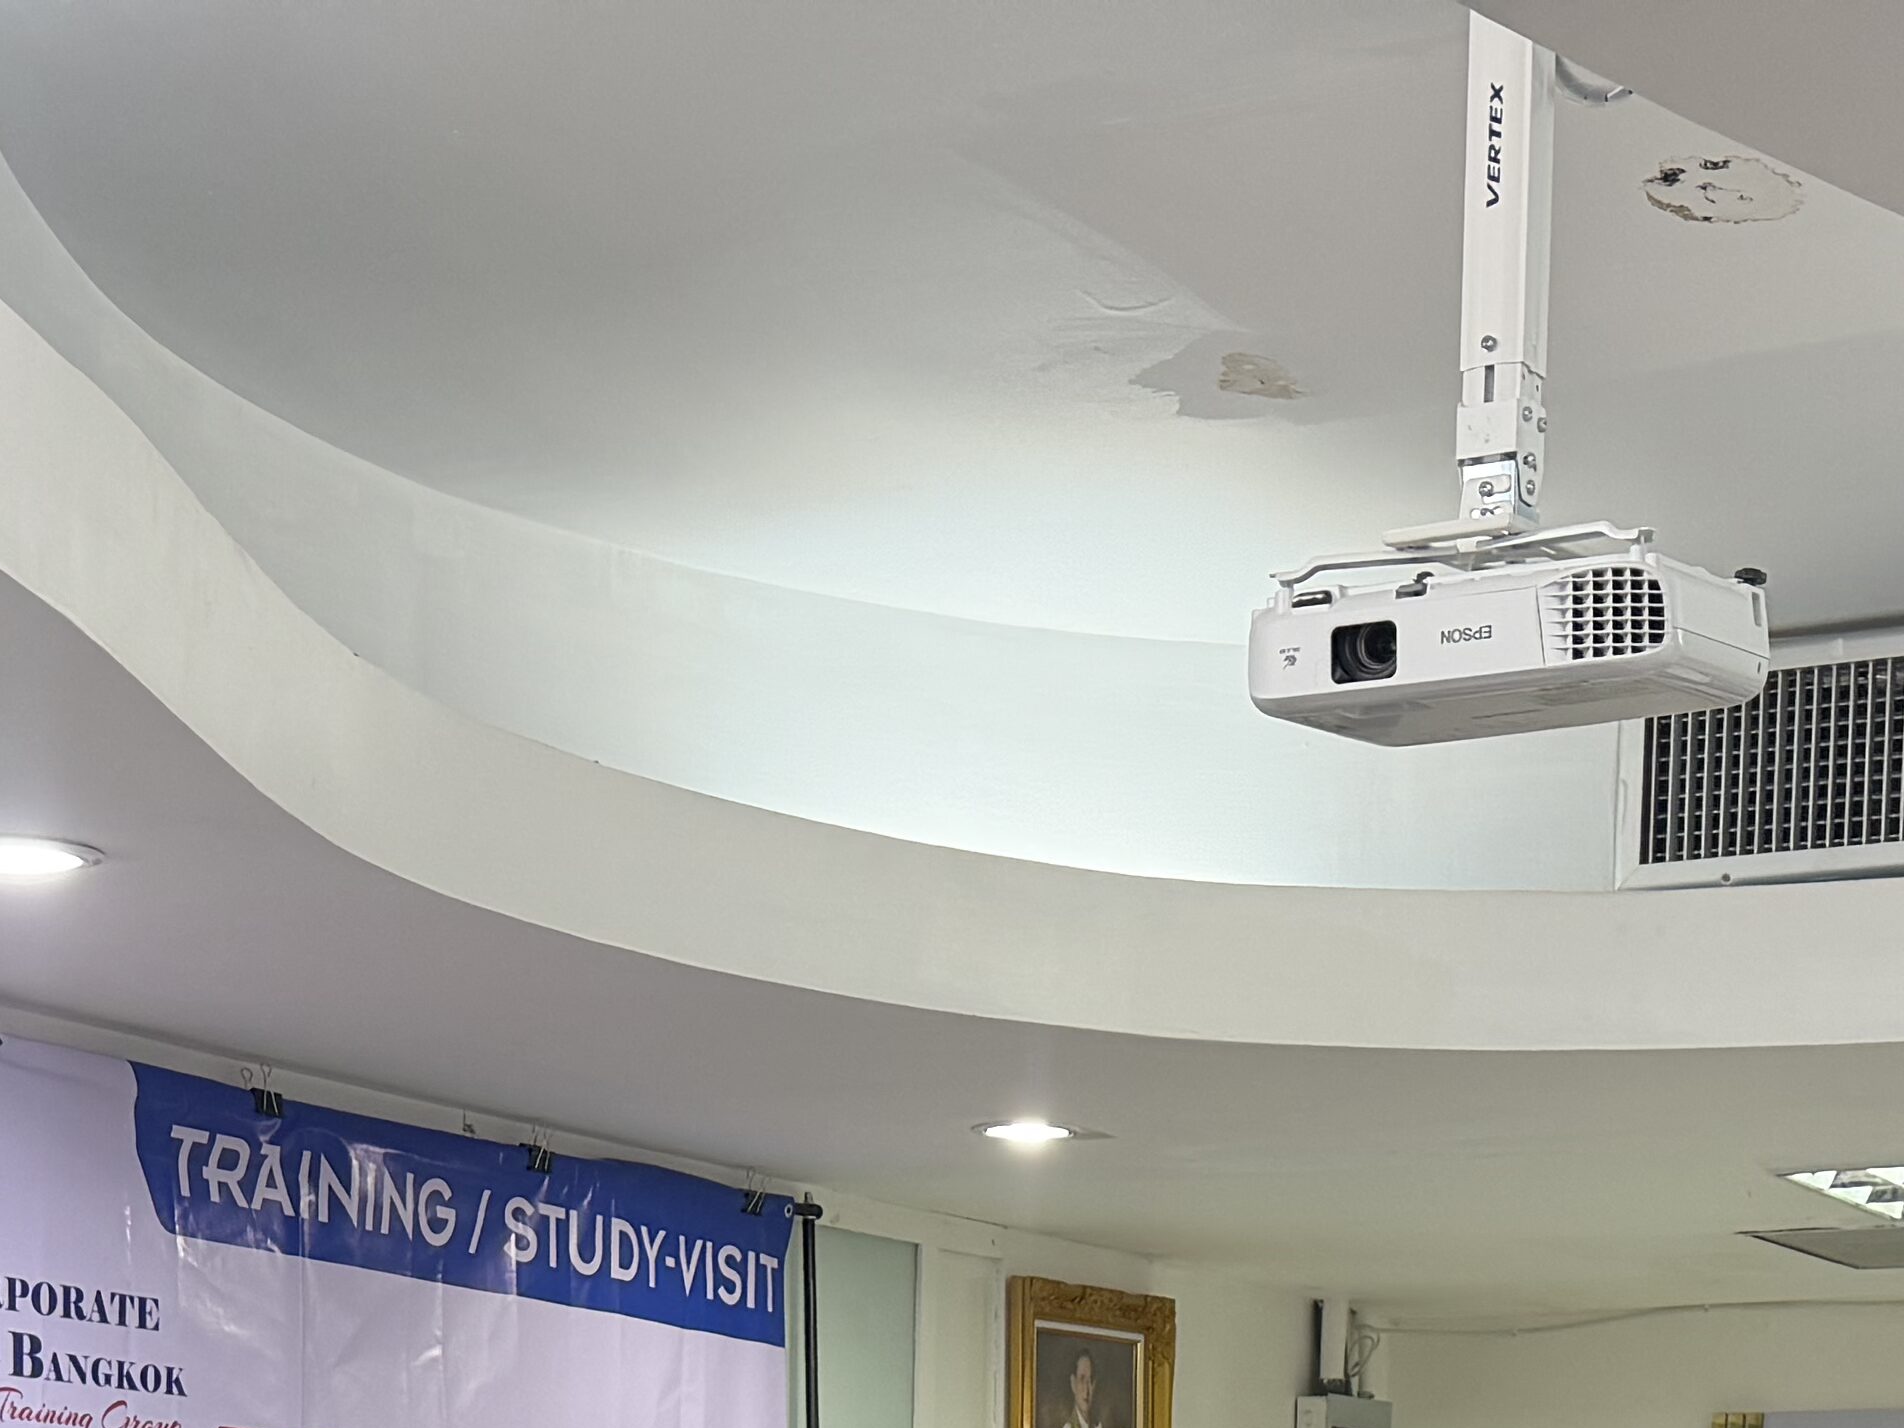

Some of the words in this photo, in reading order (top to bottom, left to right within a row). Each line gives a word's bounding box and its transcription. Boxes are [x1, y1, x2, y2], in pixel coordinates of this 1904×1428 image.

[1486, 82, 1504, 208] VERTEX
[1441, 625, 1492, 645] EPSON
[170, 1125, 456, 1246] TRAINING
[504, 1197, 779, 1312] STUDY-VISIT
[8, 1330, 187, 1397] BANGKOK
